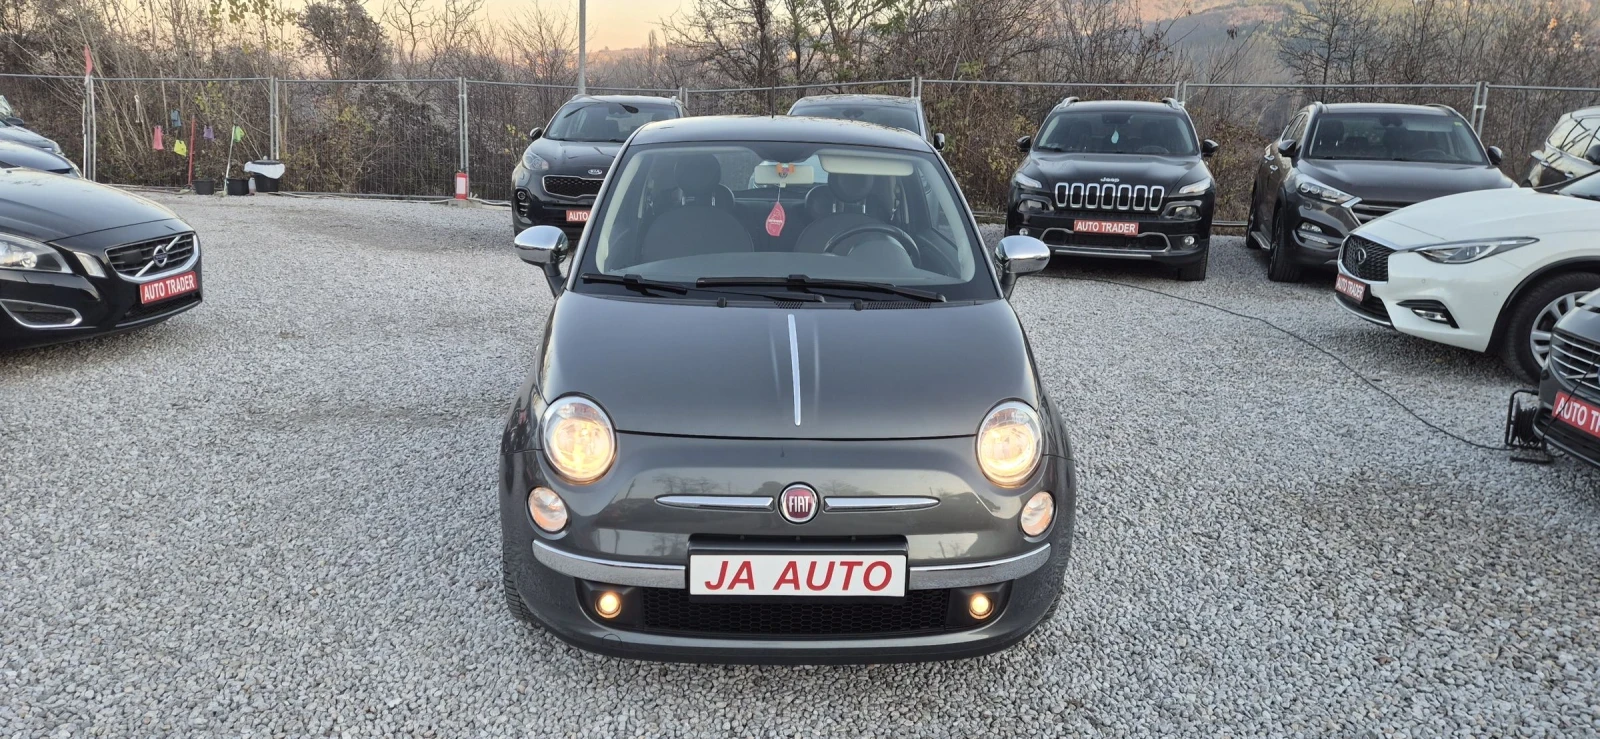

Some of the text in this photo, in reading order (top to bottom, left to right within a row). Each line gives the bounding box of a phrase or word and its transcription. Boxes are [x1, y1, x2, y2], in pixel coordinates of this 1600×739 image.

[568, 211, 588, 221] AUTO
[1076, 221, 1136, 233] AUTO TRADER
[144, 274, 195, 301] AUTO TRADER
[1555, 396, 1588, 426] AUTO
[788, 495, 810, 513] FIAT
[704, 560, 893, 591] JA AUTO
